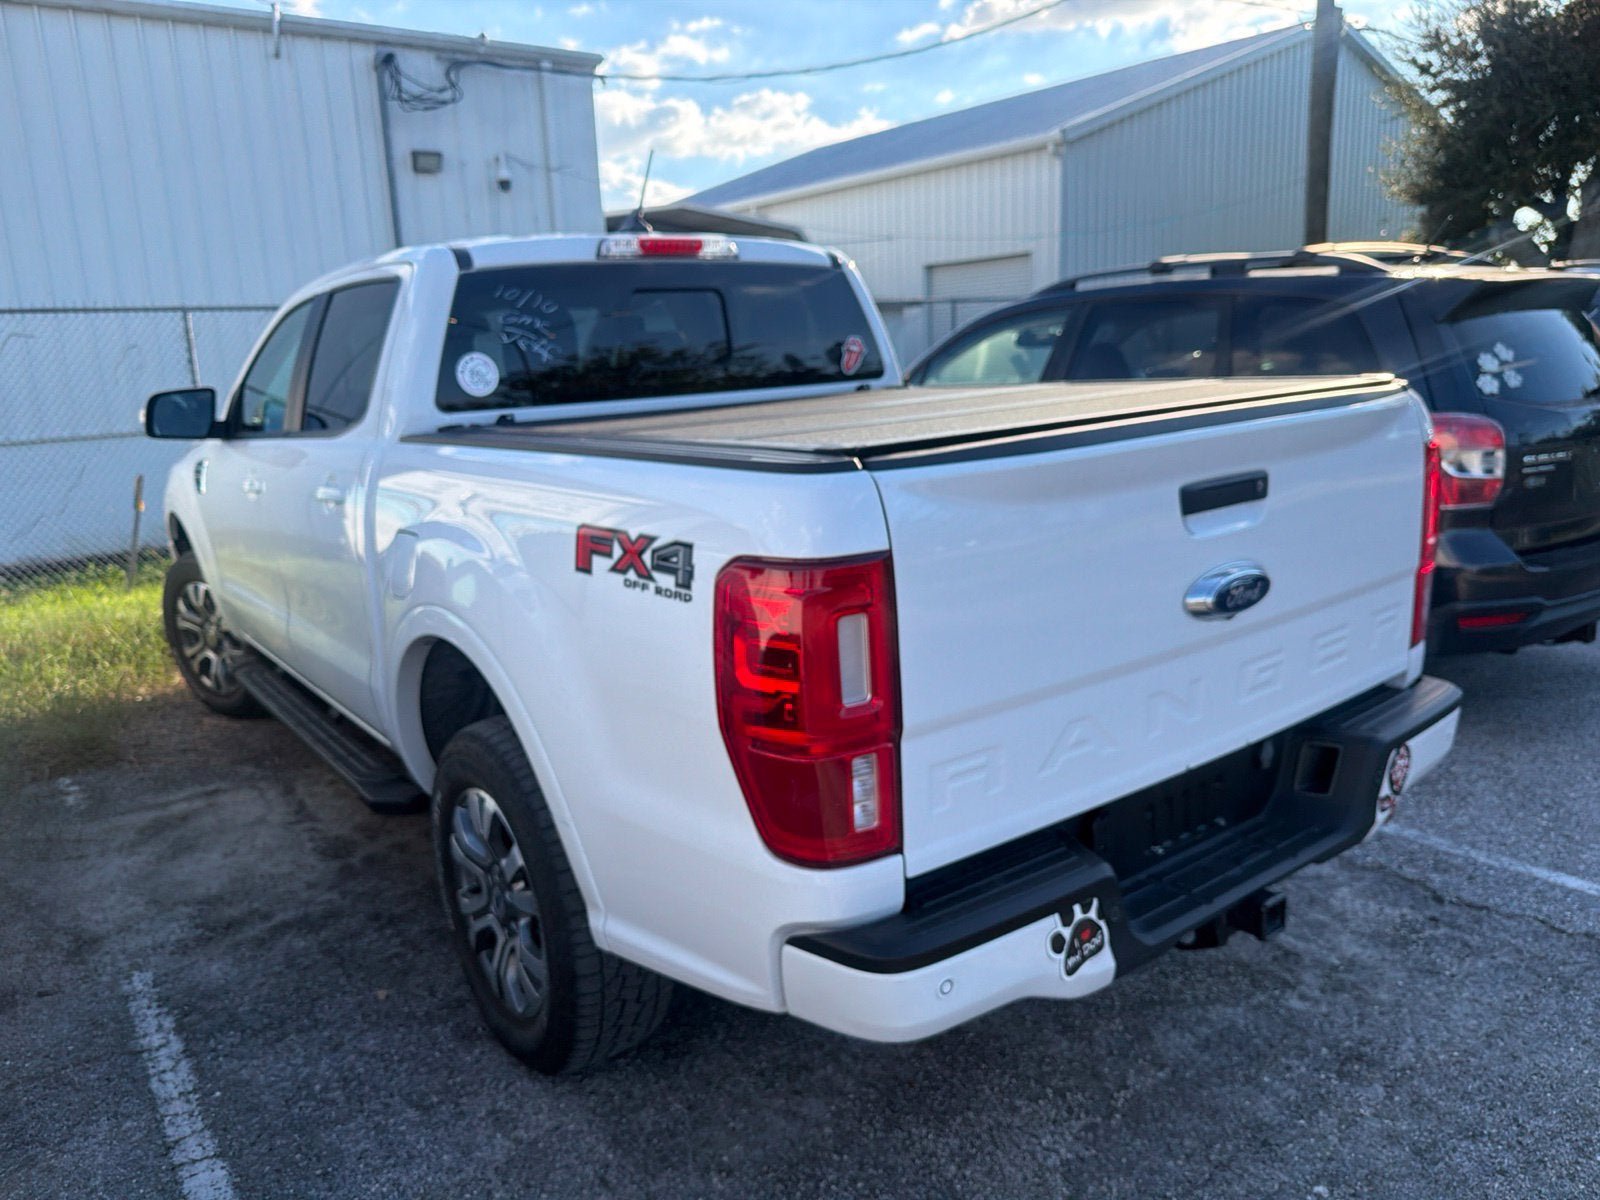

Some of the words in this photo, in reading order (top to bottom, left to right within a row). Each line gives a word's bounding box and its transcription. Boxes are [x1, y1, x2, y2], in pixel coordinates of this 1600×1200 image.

[575, 523, 695, 591] FX4
[623, 578, 650, 592] OFF
[654, 585, 693, 603] ROAD
[1226, 579, 1263, 609] Ford
[928, 602, 1404, 816] RANGER
